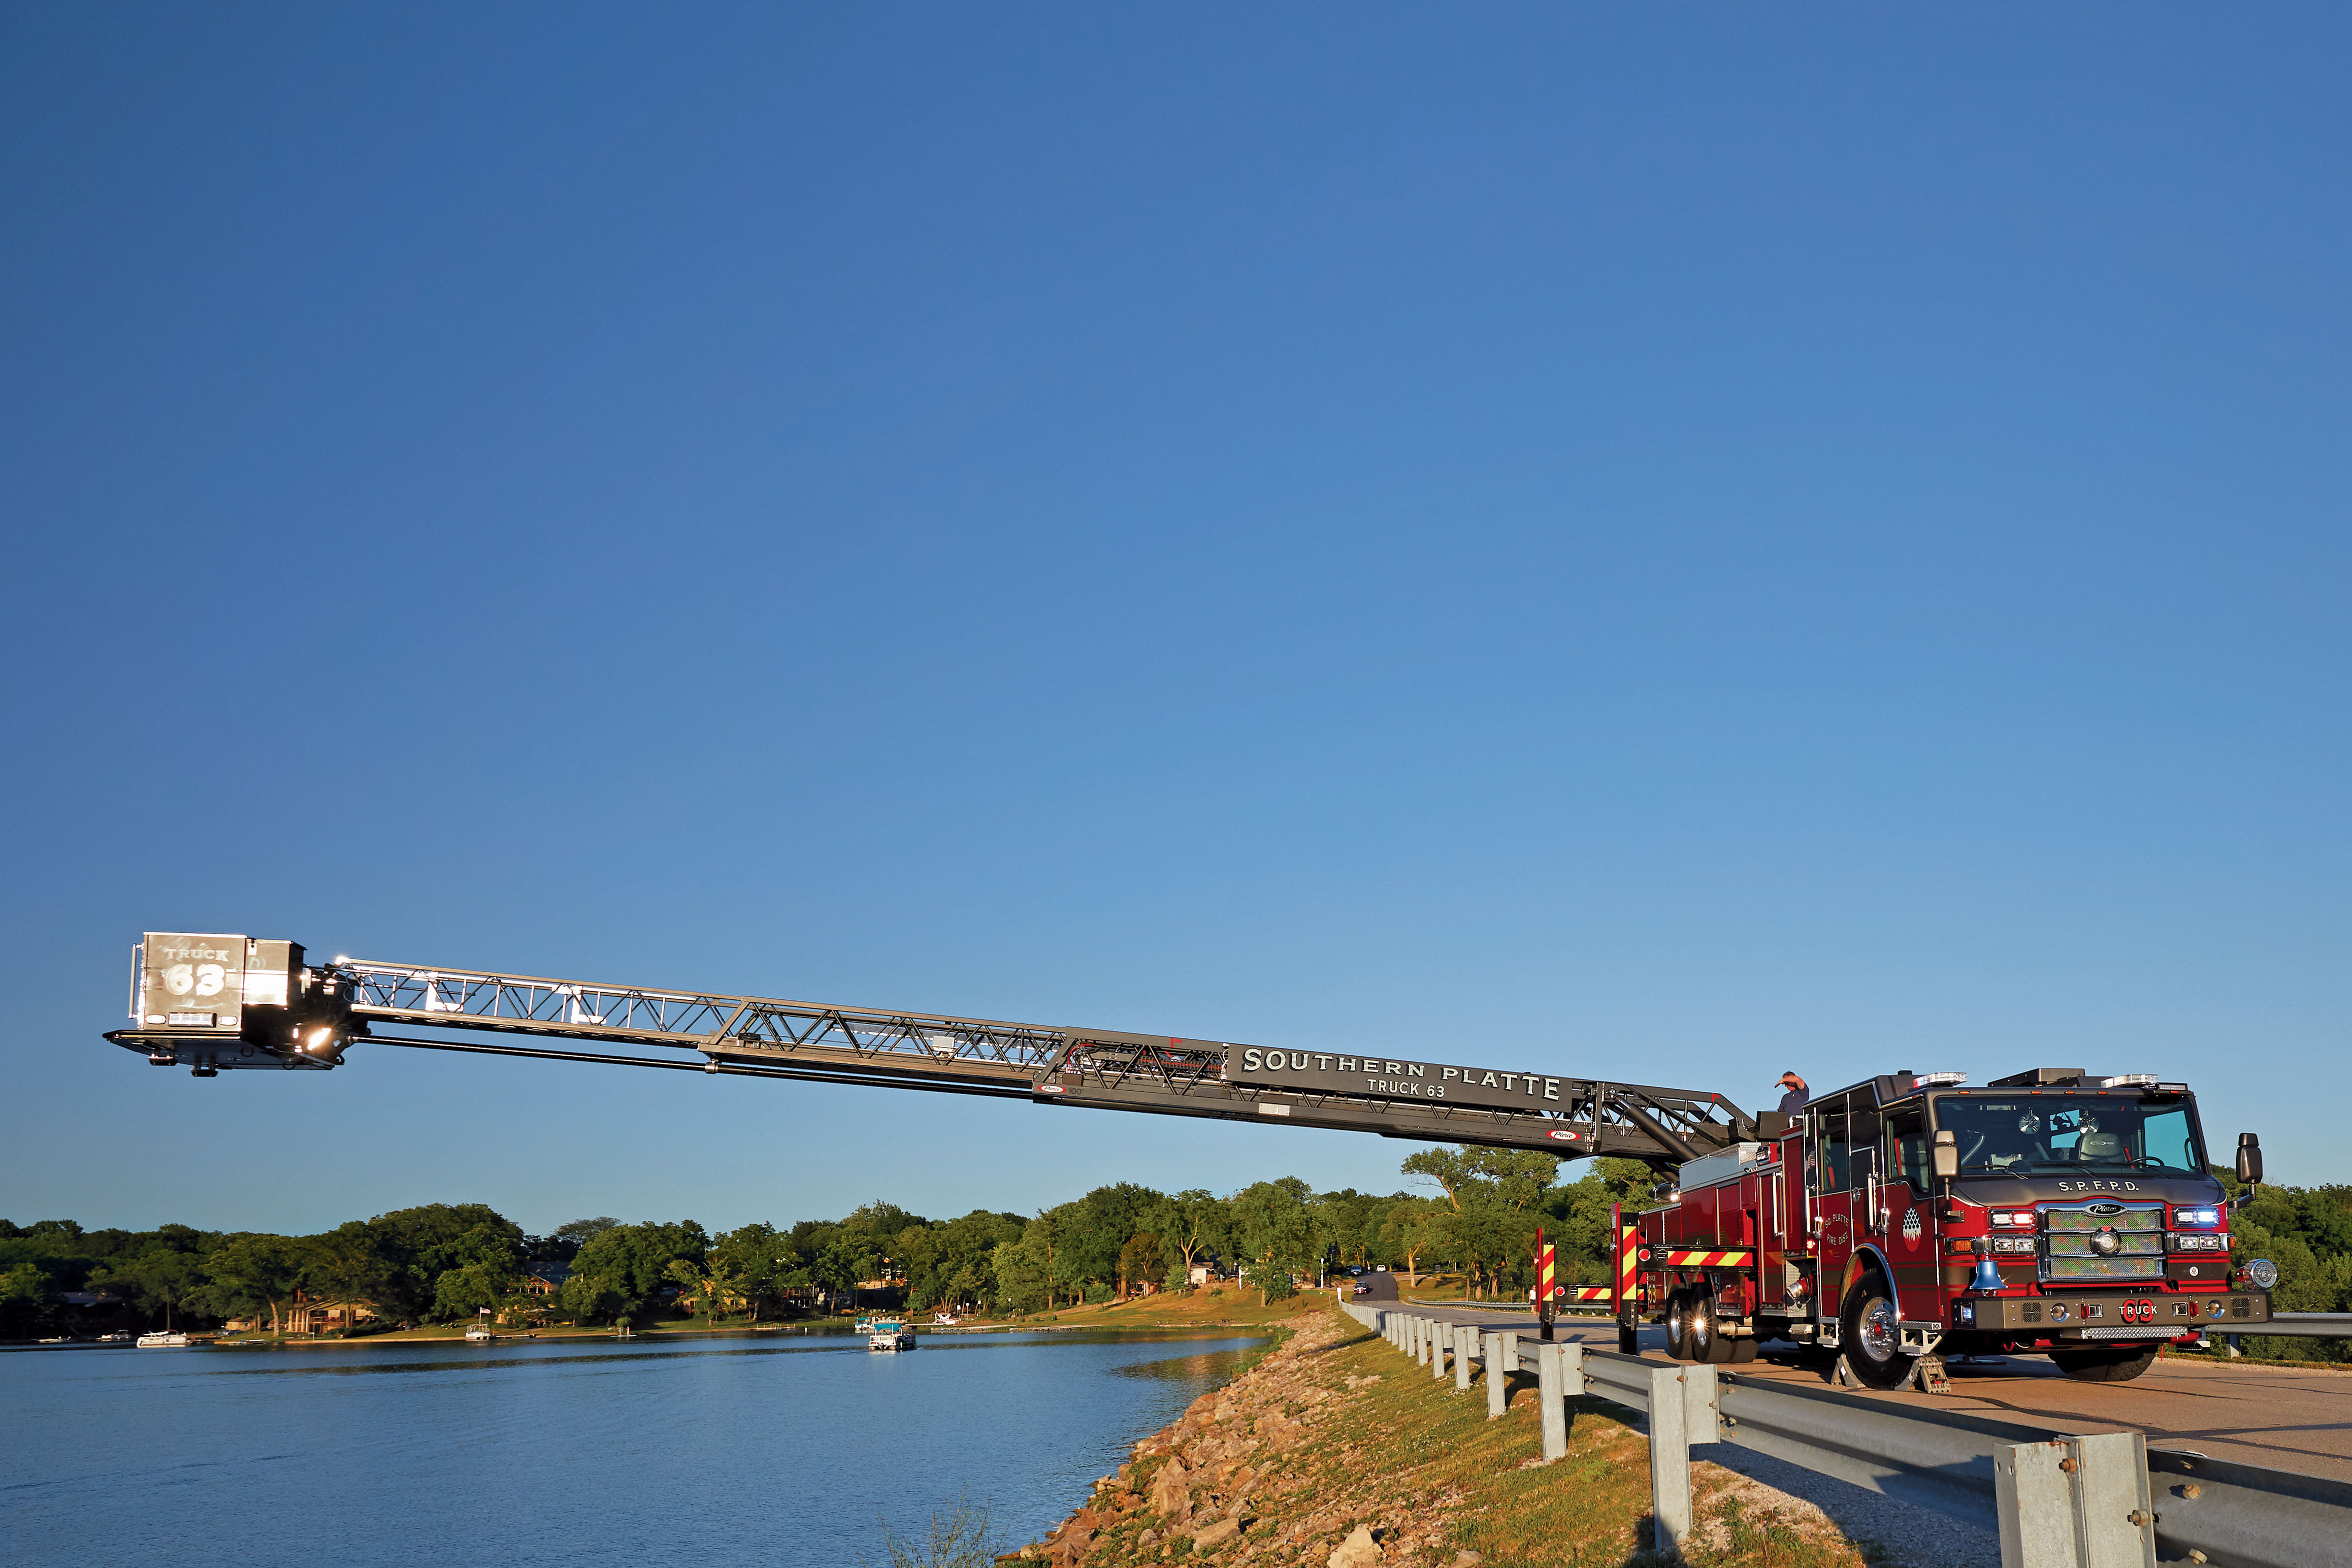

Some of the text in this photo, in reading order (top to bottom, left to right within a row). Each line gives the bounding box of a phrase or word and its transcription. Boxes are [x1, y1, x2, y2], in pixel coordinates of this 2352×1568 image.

[164, 949, 230, 962] TRUCK
[166, 963, 225, 996] 63
[1243, 1048, 1560, 1101] SOUTHERN PLATTE
[1367, 1079, 1445, 1098] TRUCK 63
[2094, 1204, 2118, 1213] Pierce
[1833, 1213, 1849, 1227] PLATTE
[1826, 1233, 1837, 1245] FIRE
[2118, 1305, 2158, 1315] TRUCK
[2122, 1299, 2154, 1323] 63
